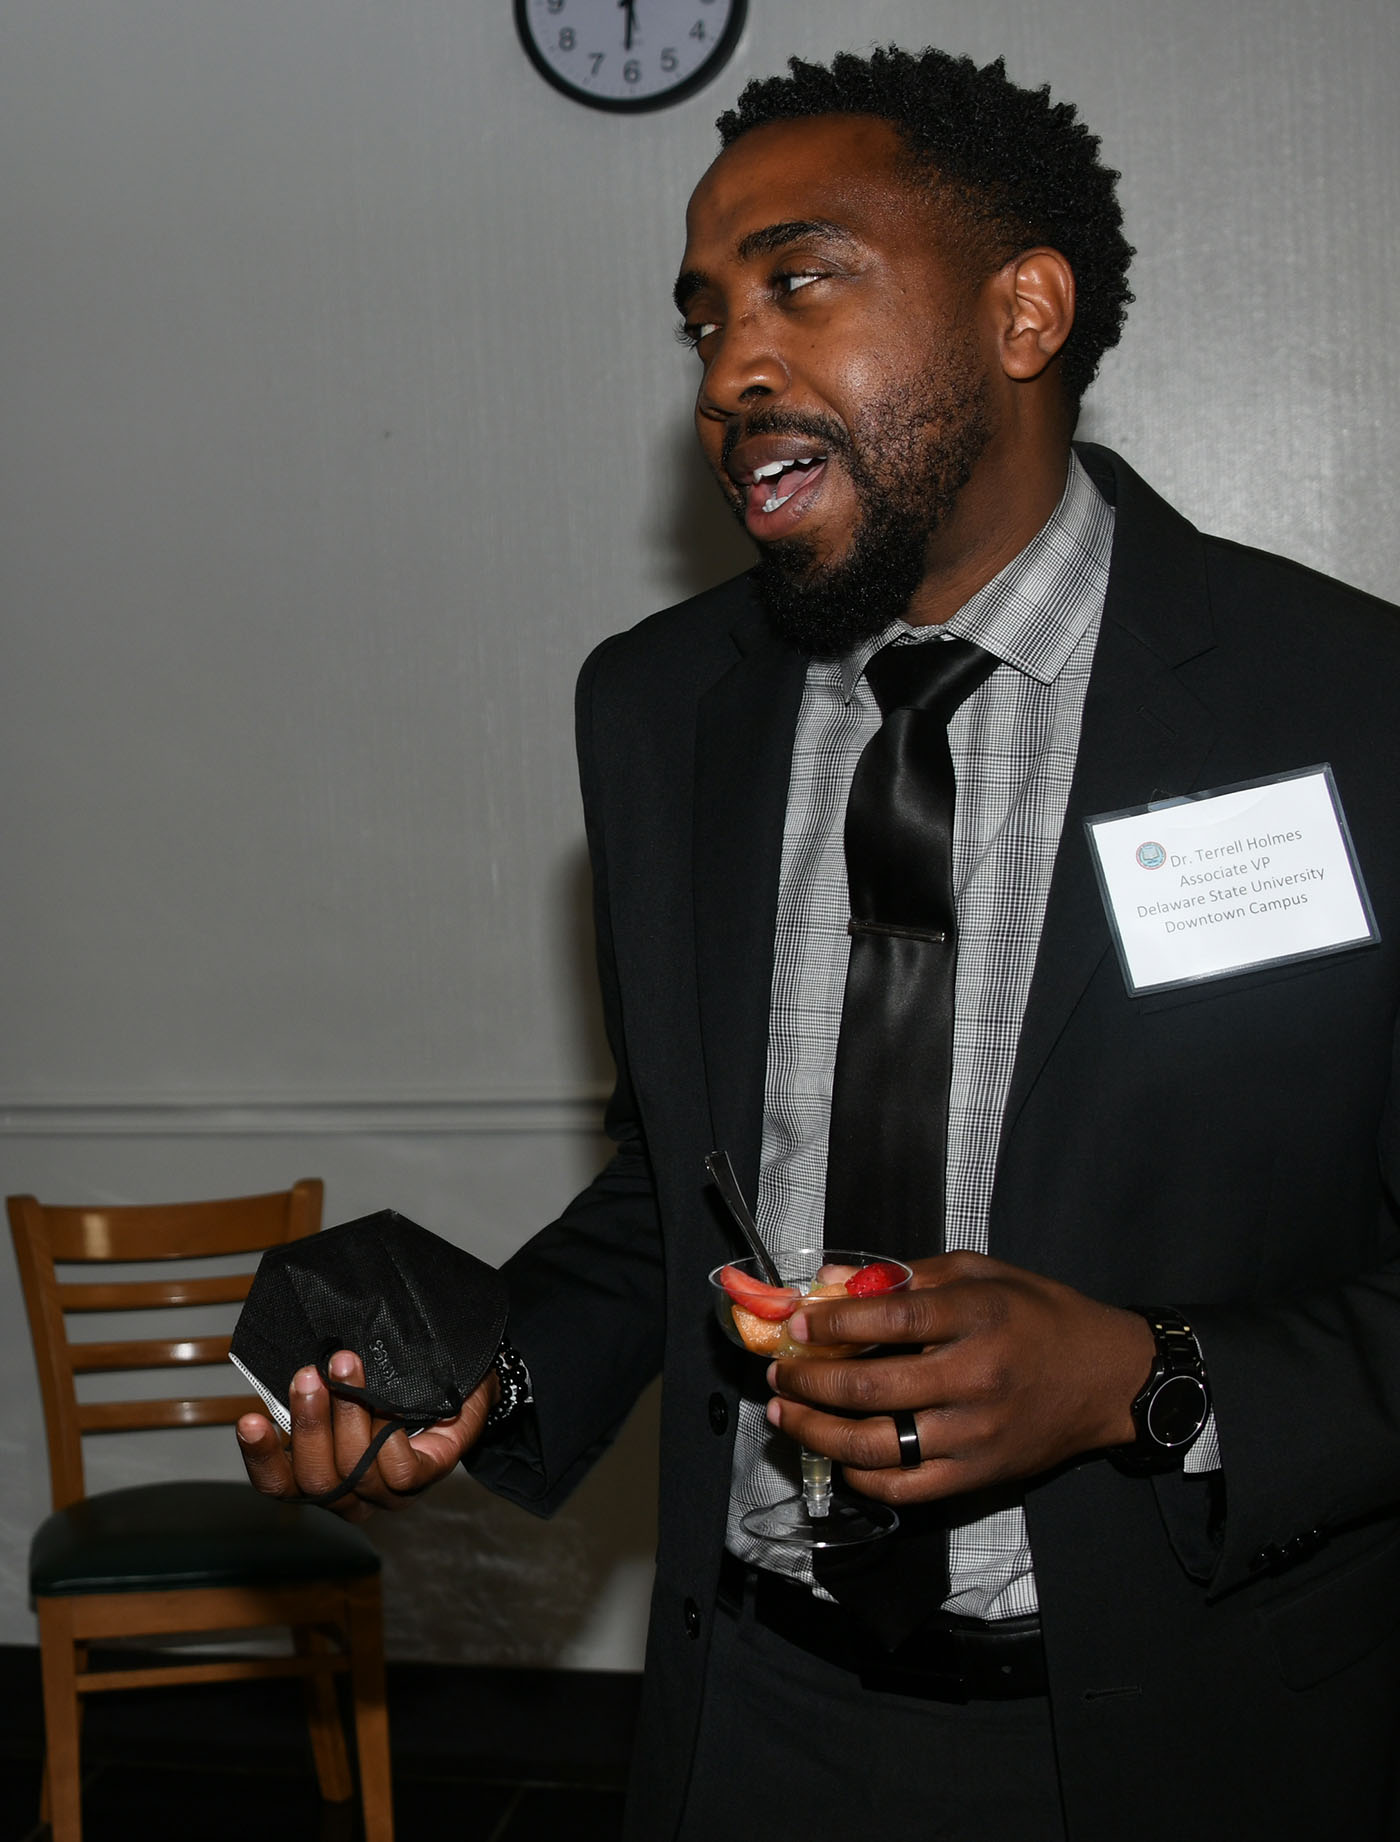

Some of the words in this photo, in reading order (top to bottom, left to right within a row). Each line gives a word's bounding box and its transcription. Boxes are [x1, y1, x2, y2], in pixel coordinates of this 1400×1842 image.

[559, 27, 576, 51] 8
[689, 20, 706, 41] 4
[588, 53, 605, 76] 7
[623, 59, 642, 84] 6
[661, 48, 679, 72] 5
[1170, 855, 1193, 868] Dr.
[1195, 840, 1243, 862] Terrell
[1246, 830, 1303, 851] Holmes
[1180, 863, 1248, 888] Associate
[1250, 856, 1271, 871] VP
[1137, 895, 1206, 918] Delaware
[1208, 886, 1248, 902] State
[1250, 867, 1324, 893] University
[1165, 907, 1246, 934] Downtown
[1249, 893, 1308, 914] Campus
